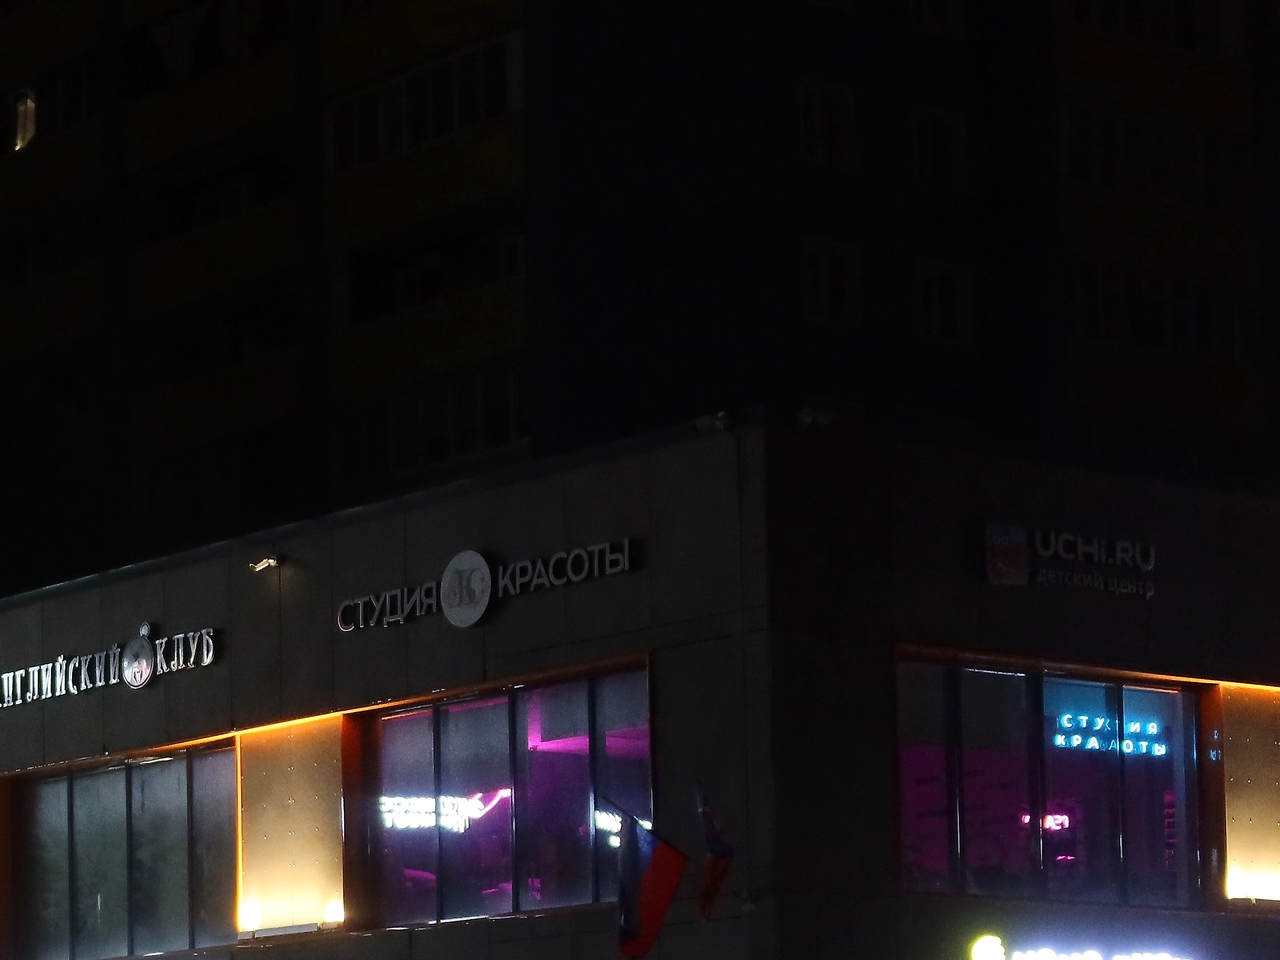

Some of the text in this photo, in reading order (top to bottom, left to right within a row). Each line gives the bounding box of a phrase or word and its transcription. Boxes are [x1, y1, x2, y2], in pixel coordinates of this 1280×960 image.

[336, 537, 630, 633] СТУДИЯ КРАСОТЫ
[1036, 567, 1155, 600] детский центр
[155, 628, 215, 675] КЛУБ
[1060, 713, 1158, 735] СТУИЯ
[1054, 734, 1167, 756] КРАОТЫ
